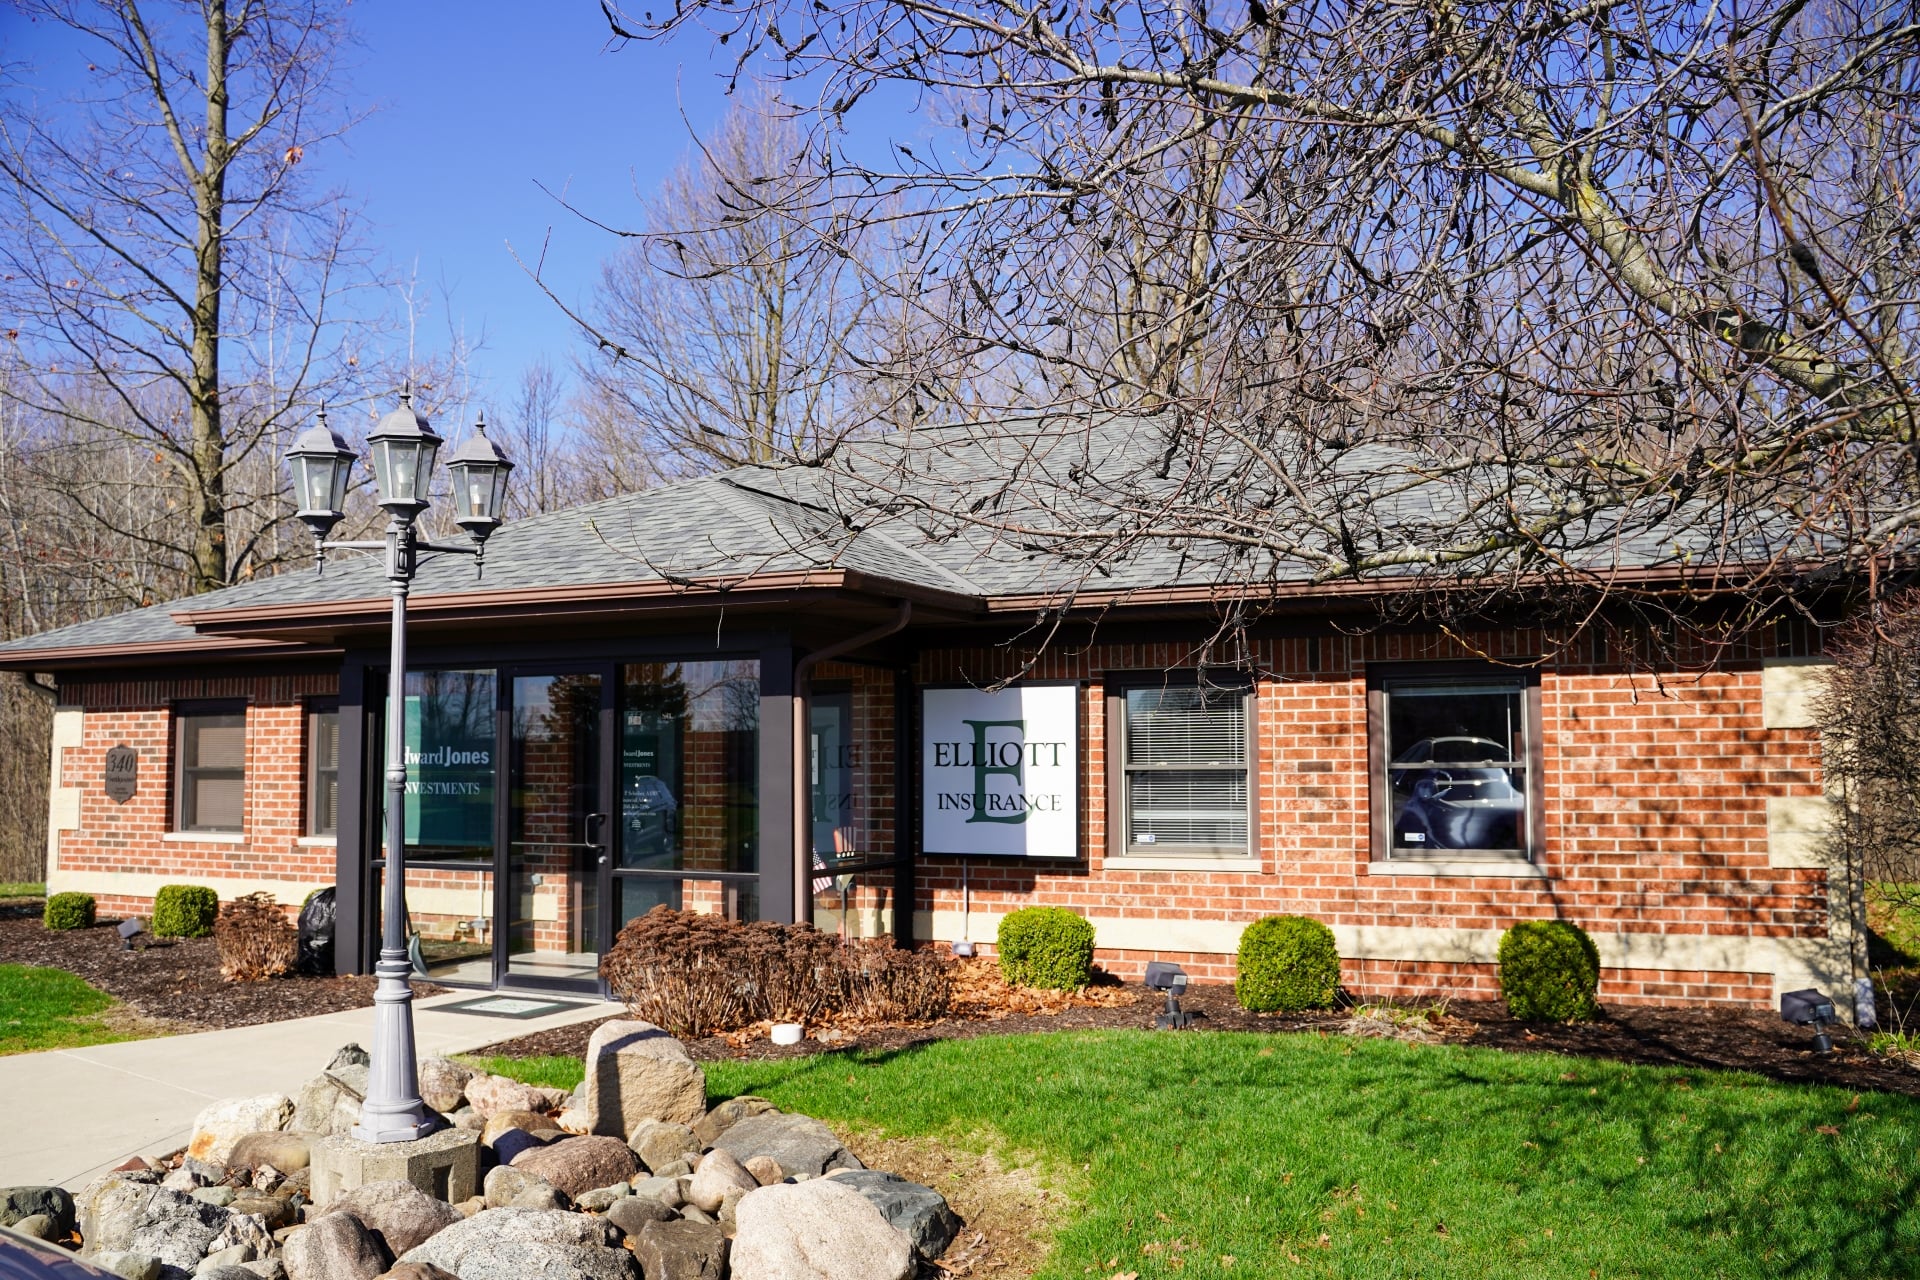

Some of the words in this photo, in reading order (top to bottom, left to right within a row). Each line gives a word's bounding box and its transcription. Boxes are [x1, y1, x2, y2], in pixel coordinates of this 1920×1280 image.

[110, 753, 134, 773] 340
[404, 745, 444, 765] dward
[444, 745, 490, 768] Jones
[933, 741, 1067, 768] ELLIOTT
[404, 781, 481, 795] NVESTMENTS
[937, 793, 1063, 812] INSURANCE
